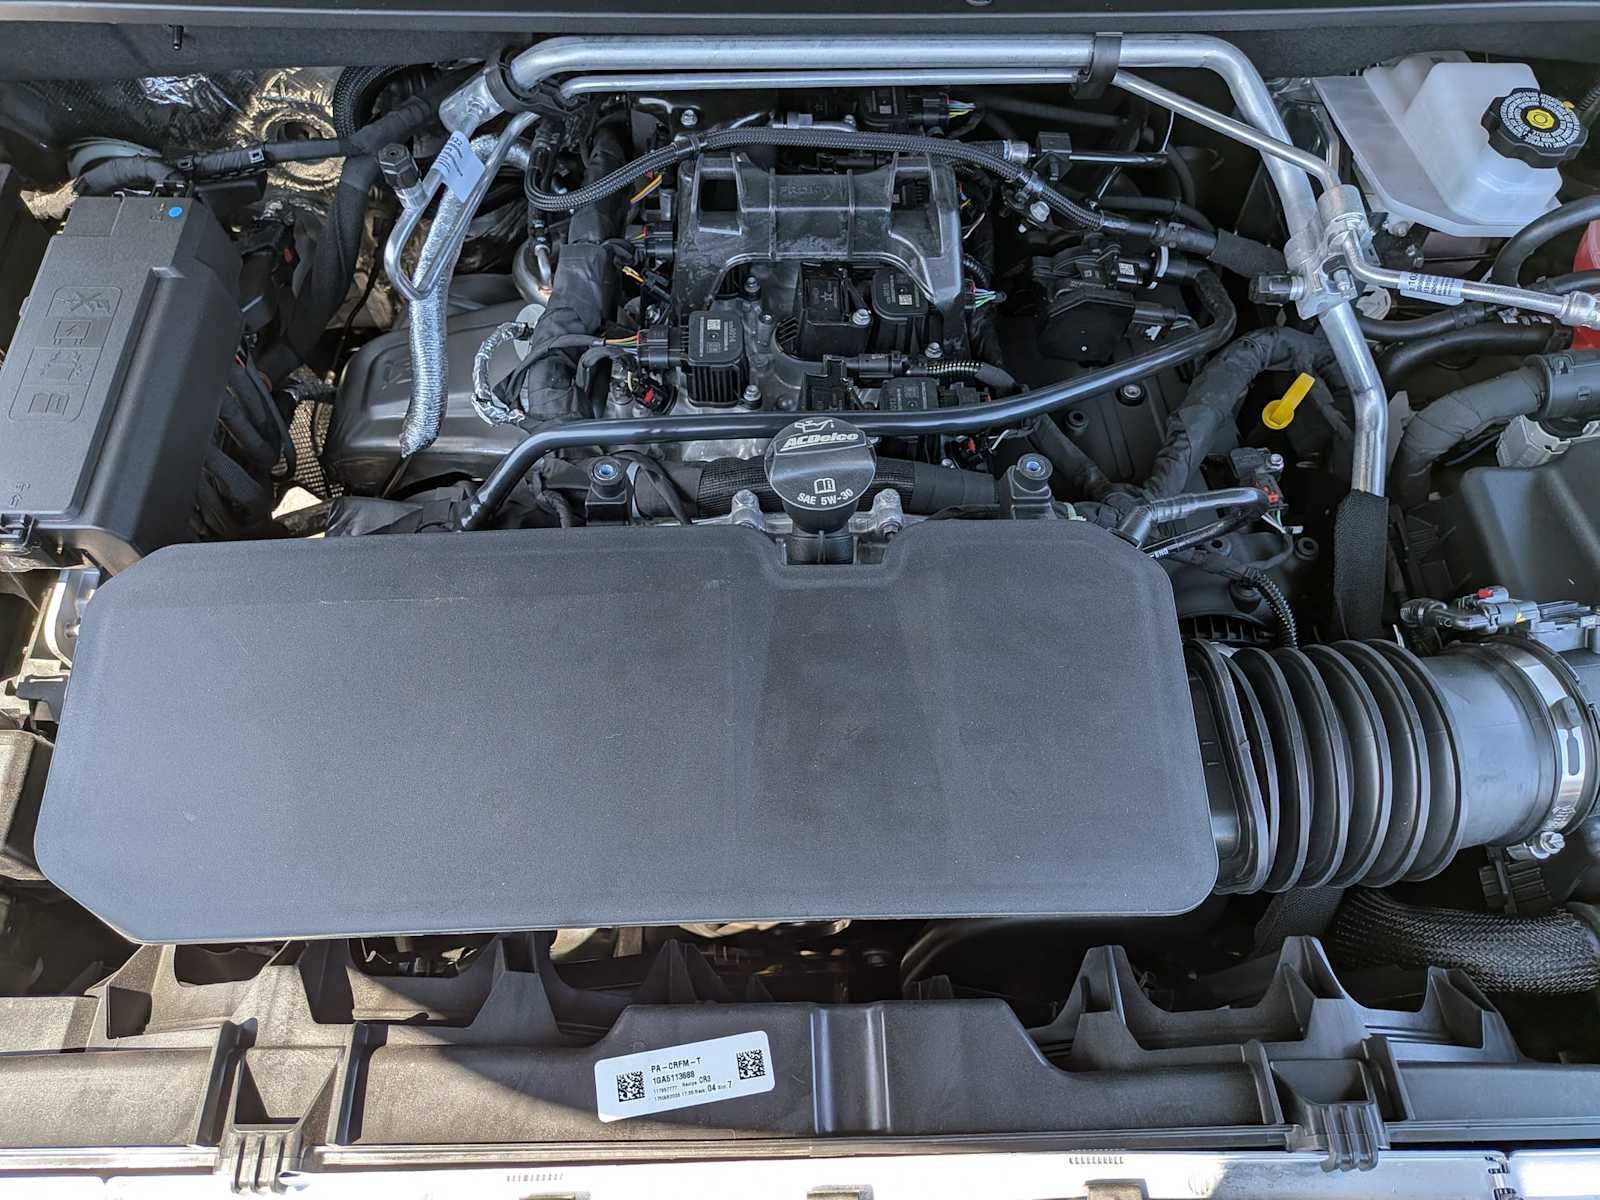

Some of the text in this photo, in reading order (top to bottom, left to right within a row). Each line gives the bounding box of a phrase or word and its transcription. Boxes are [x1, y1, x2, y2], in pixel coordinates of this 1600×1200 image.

[783, 432, 859, 449] ACDelco
[797, 488, 854, 506] SAE 5W-30
